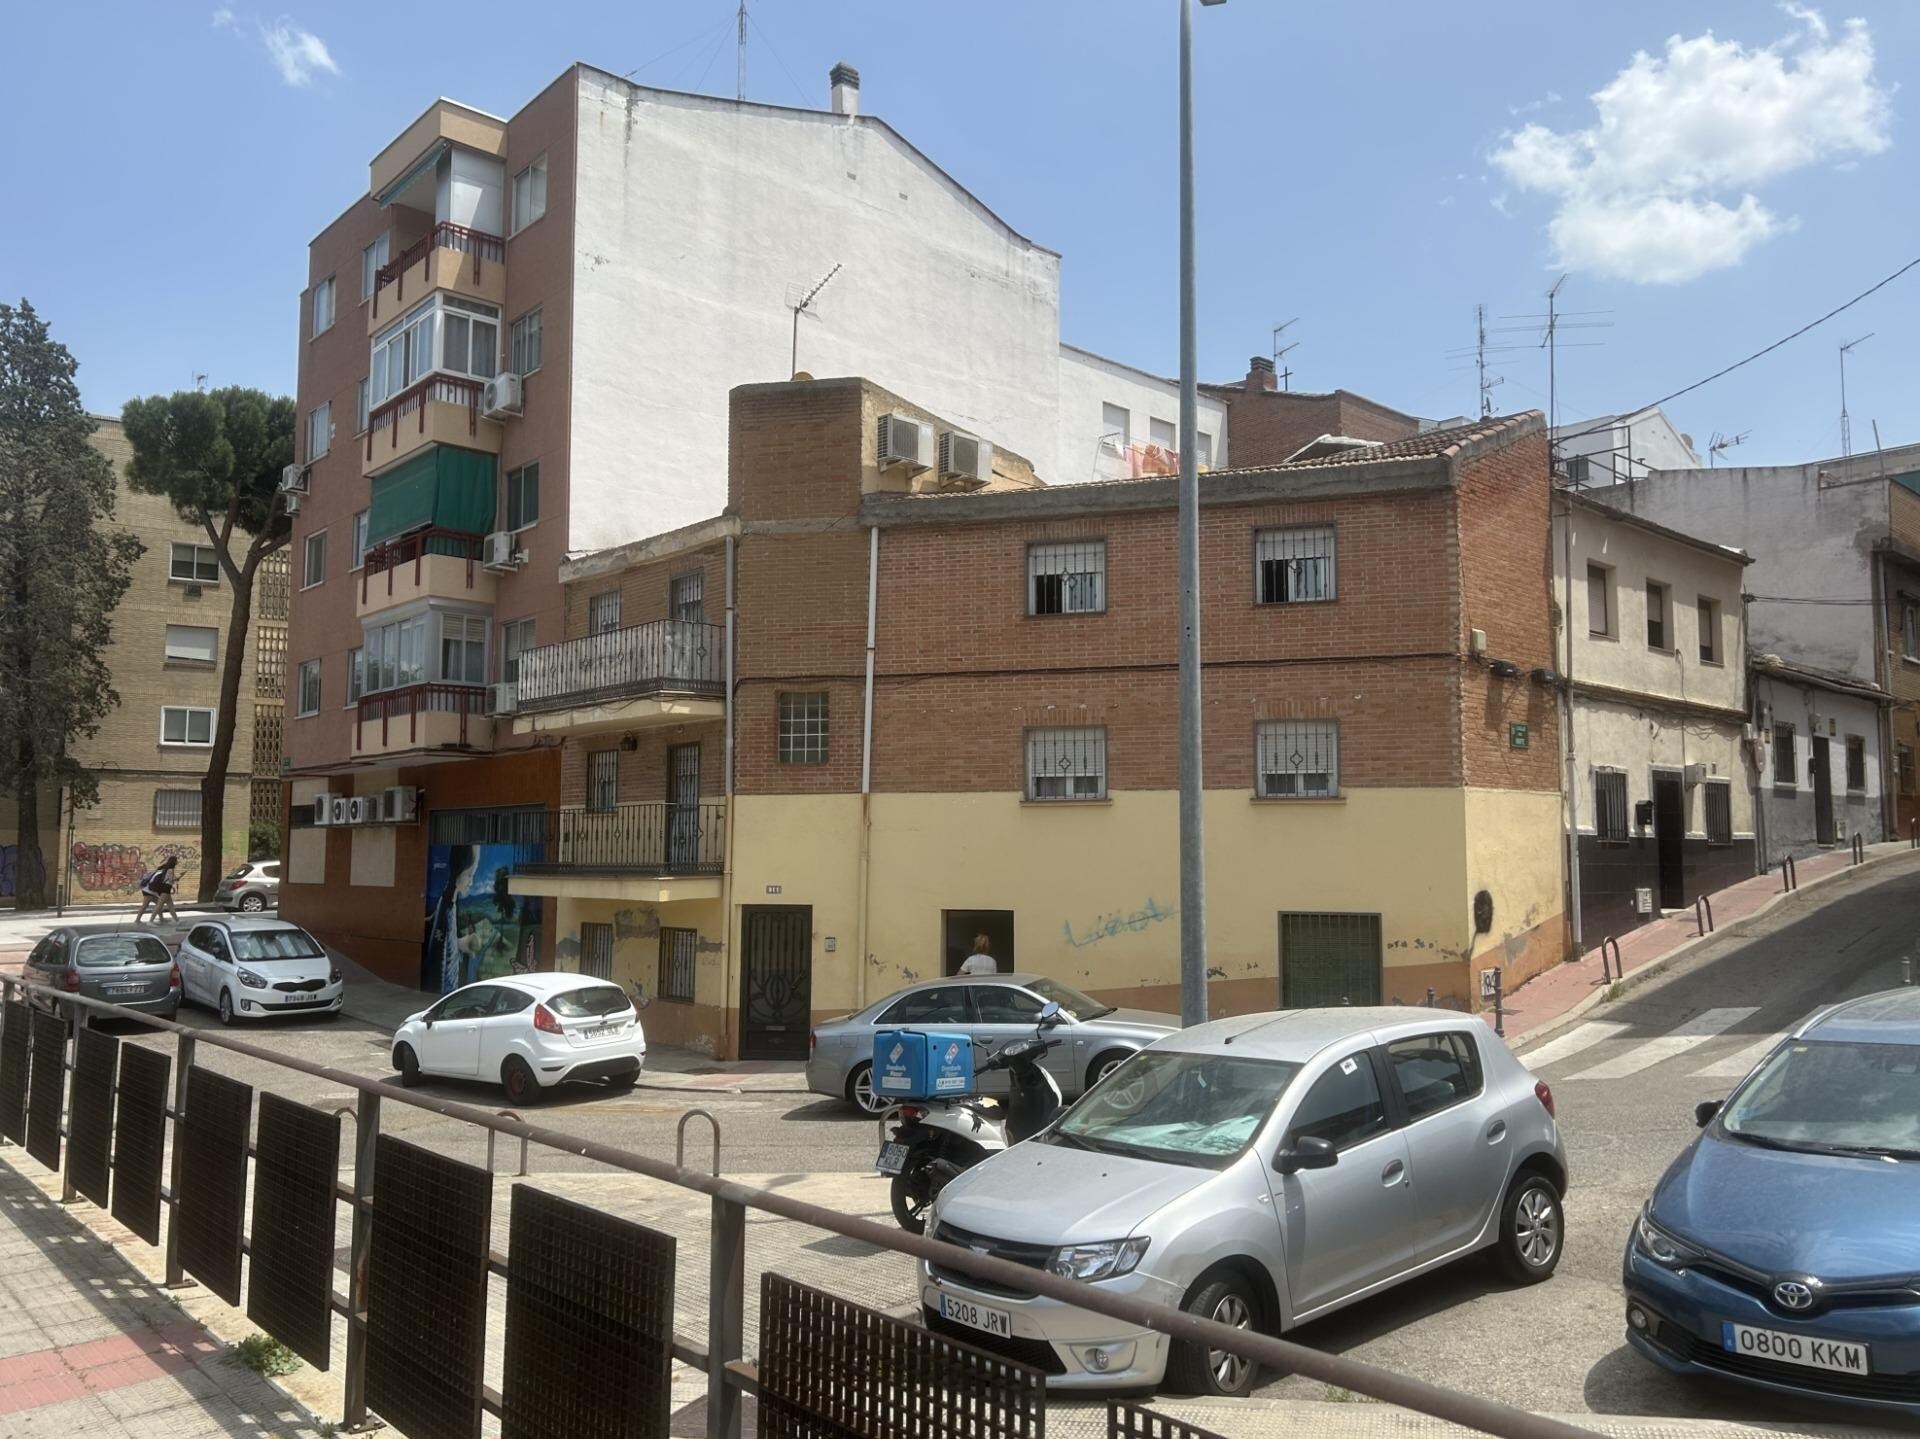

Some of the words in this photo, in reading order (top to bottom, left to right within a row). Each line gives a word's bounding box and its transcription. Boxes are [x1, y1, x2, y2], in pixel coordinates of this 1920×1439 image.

[947, 1299, 977, 1325] 5208
[983, 1311, 1007, 1334] JRW
[1741, 1330, 1802, 1359] 0800
[1811, 1341, 1860, 1370] KKM
